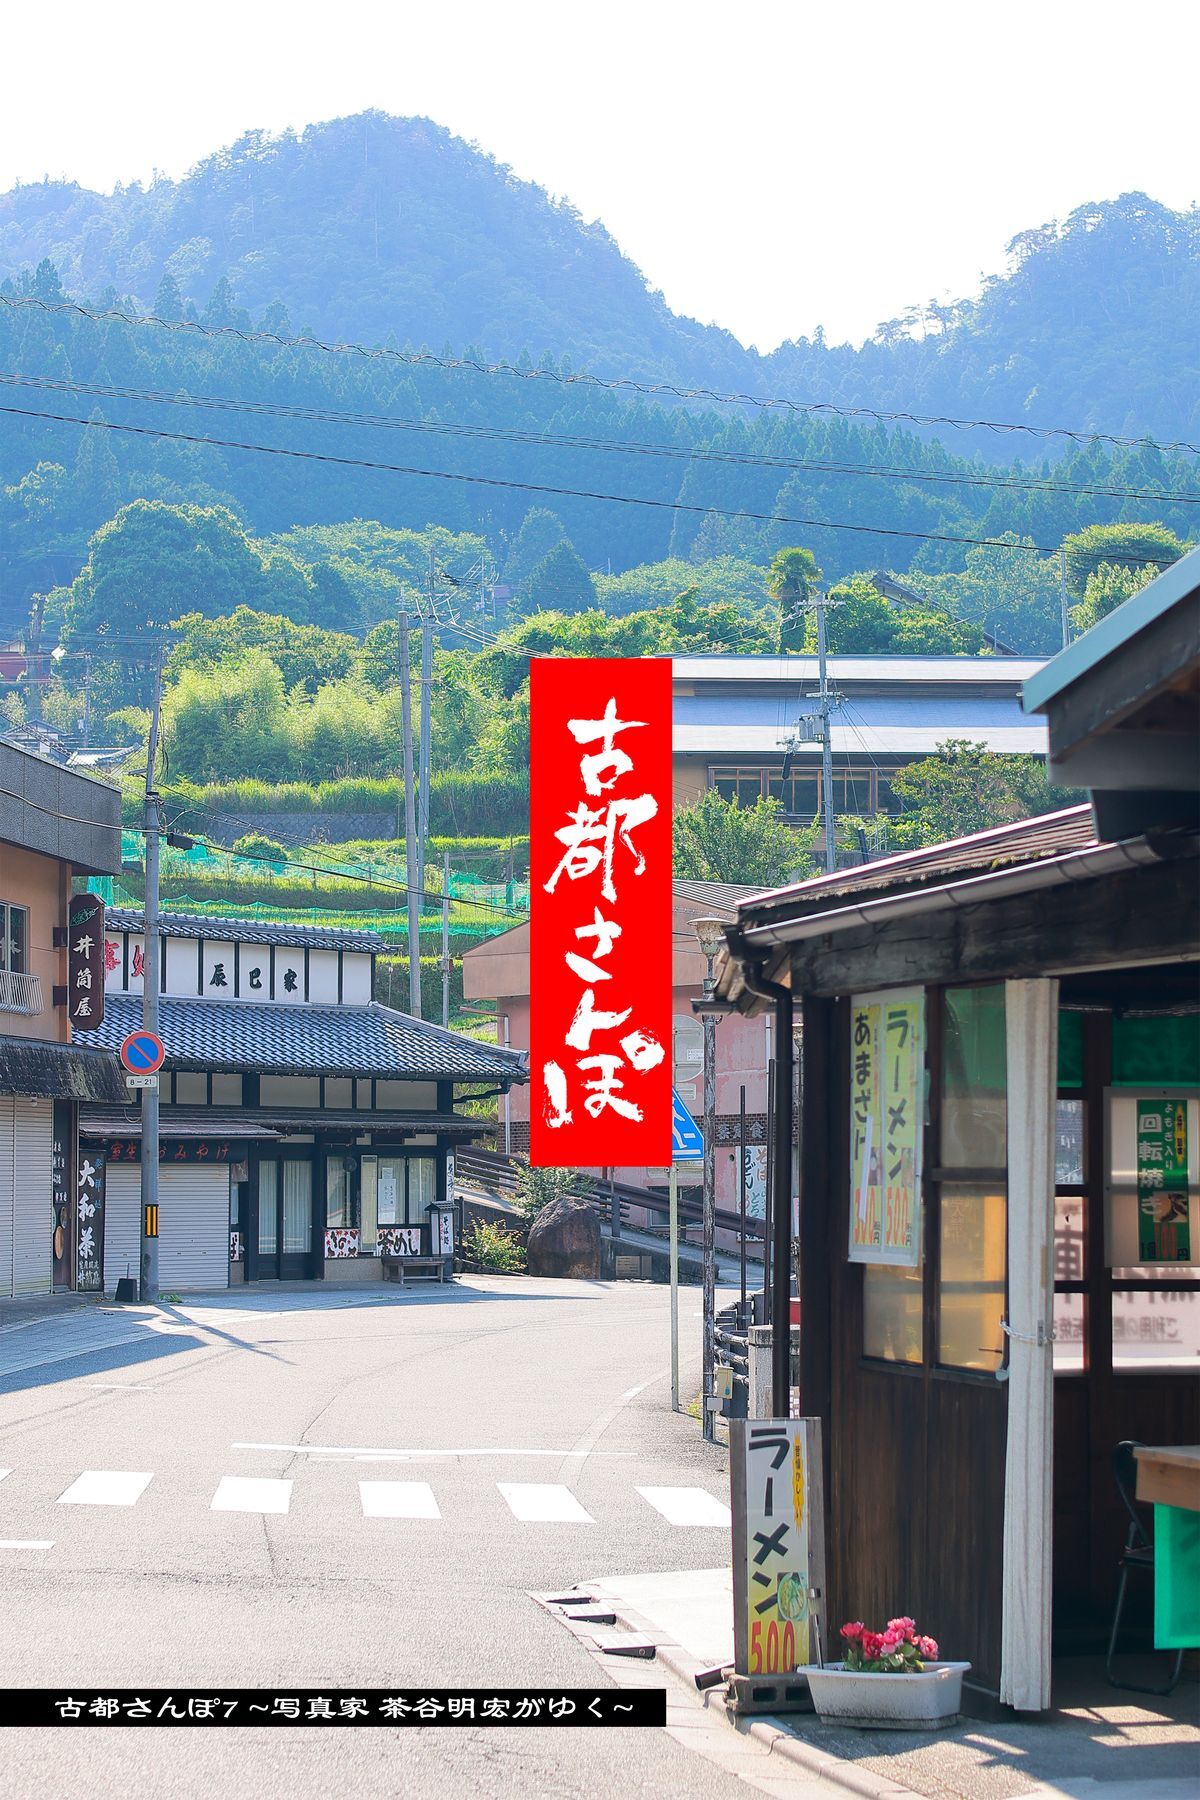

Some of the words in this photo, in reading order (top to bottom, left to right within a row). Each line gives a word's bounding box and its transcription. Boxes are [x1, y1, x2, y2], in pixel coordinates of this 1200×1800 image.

[73, 934, 95, 1017] 井筒屋
[886, 1009, 909, 1180] ラーメン
[78, 1159, 96, 1260] 大和茶
[1138, 1113, 1164, 1216] 回転焼き
[748, 1427, 791, 1615] ラーメン
